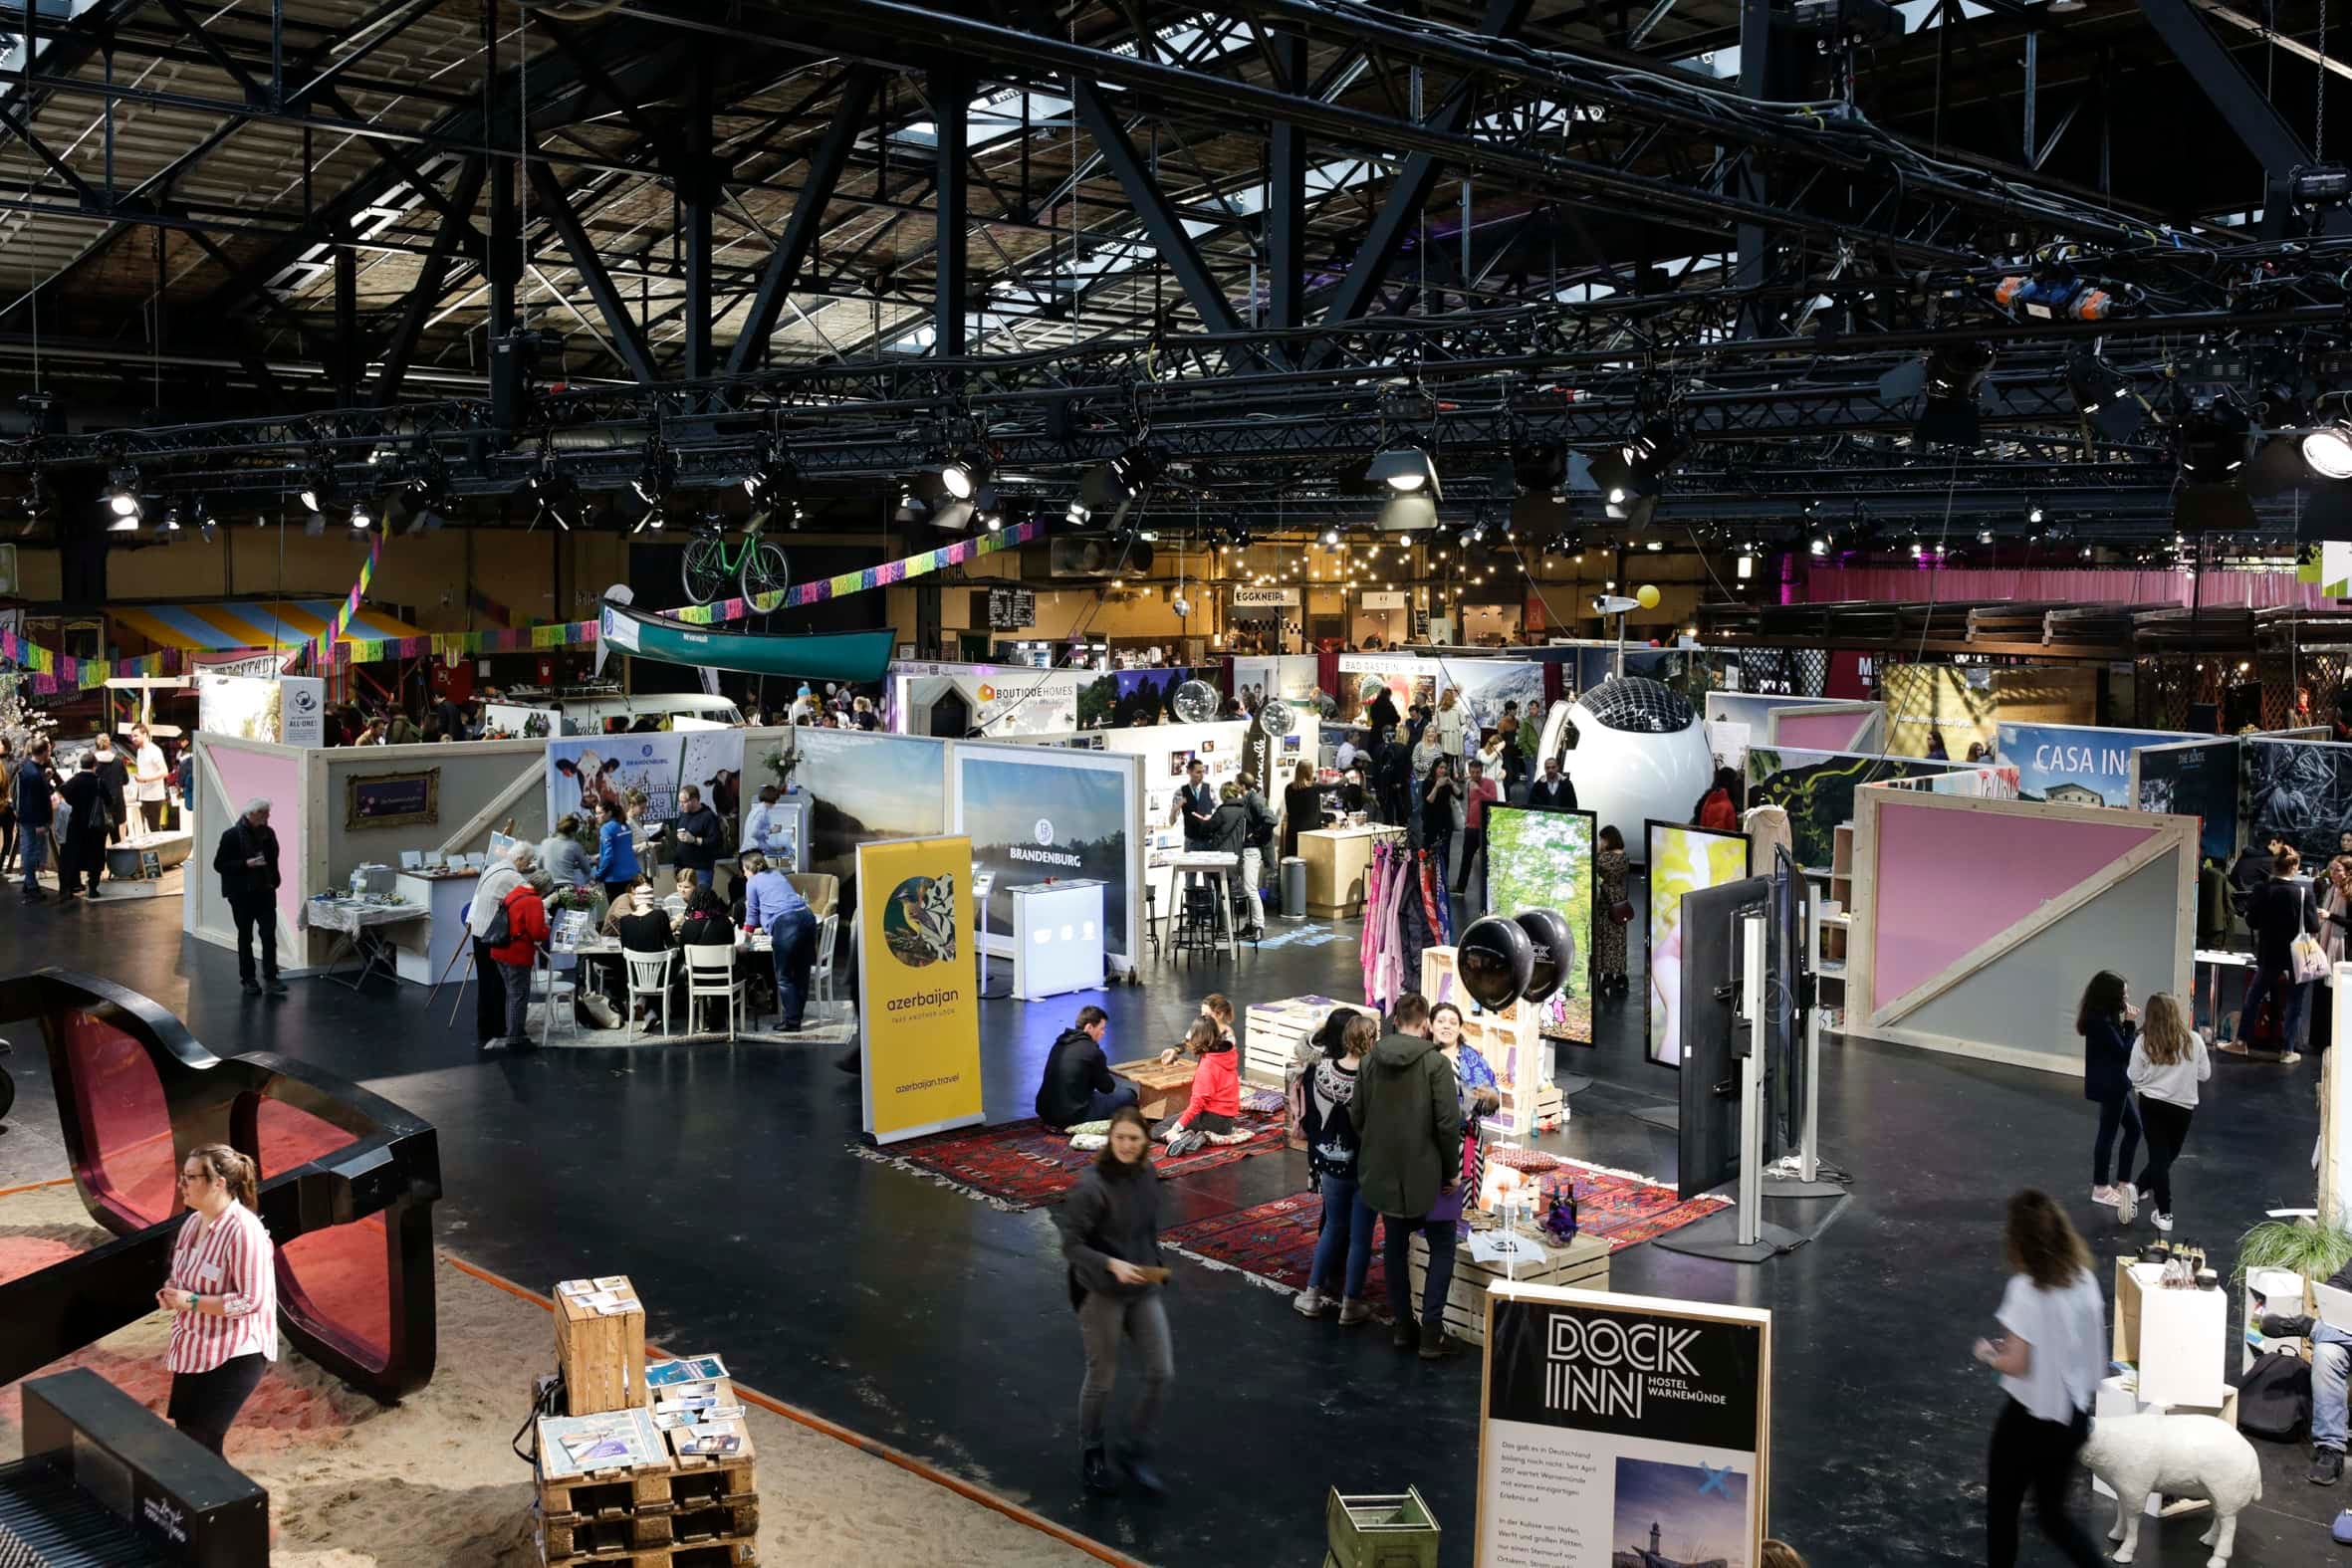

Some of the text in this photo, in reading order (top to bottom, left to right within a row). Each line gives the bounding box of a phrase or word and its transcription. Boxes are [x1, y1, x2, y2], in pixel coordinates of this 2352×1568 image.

[1345, 661, 1399, 672] BAD GASTEIN
[996, 686, 1073, 699] BOUTIQUEHOMES
[2035, 745, 2094, 774] CASA
[1010, 847, 1081, 867] BRANDENBURG
[886, 989, 959, 1011] azerbaijan
[895, 1072, 960, 1094] azerbaijan.travel
[1547, 1313, 1702, 1376] DOCK
[1545, 1362, 1643, 1419] INN
[1648, 1376, 1688, 1390] HOSTEL
[1648, 1387, 1728, 1405] WARNEMÜNDE
[1548, 1448, 1591, 1458] Deutschland
